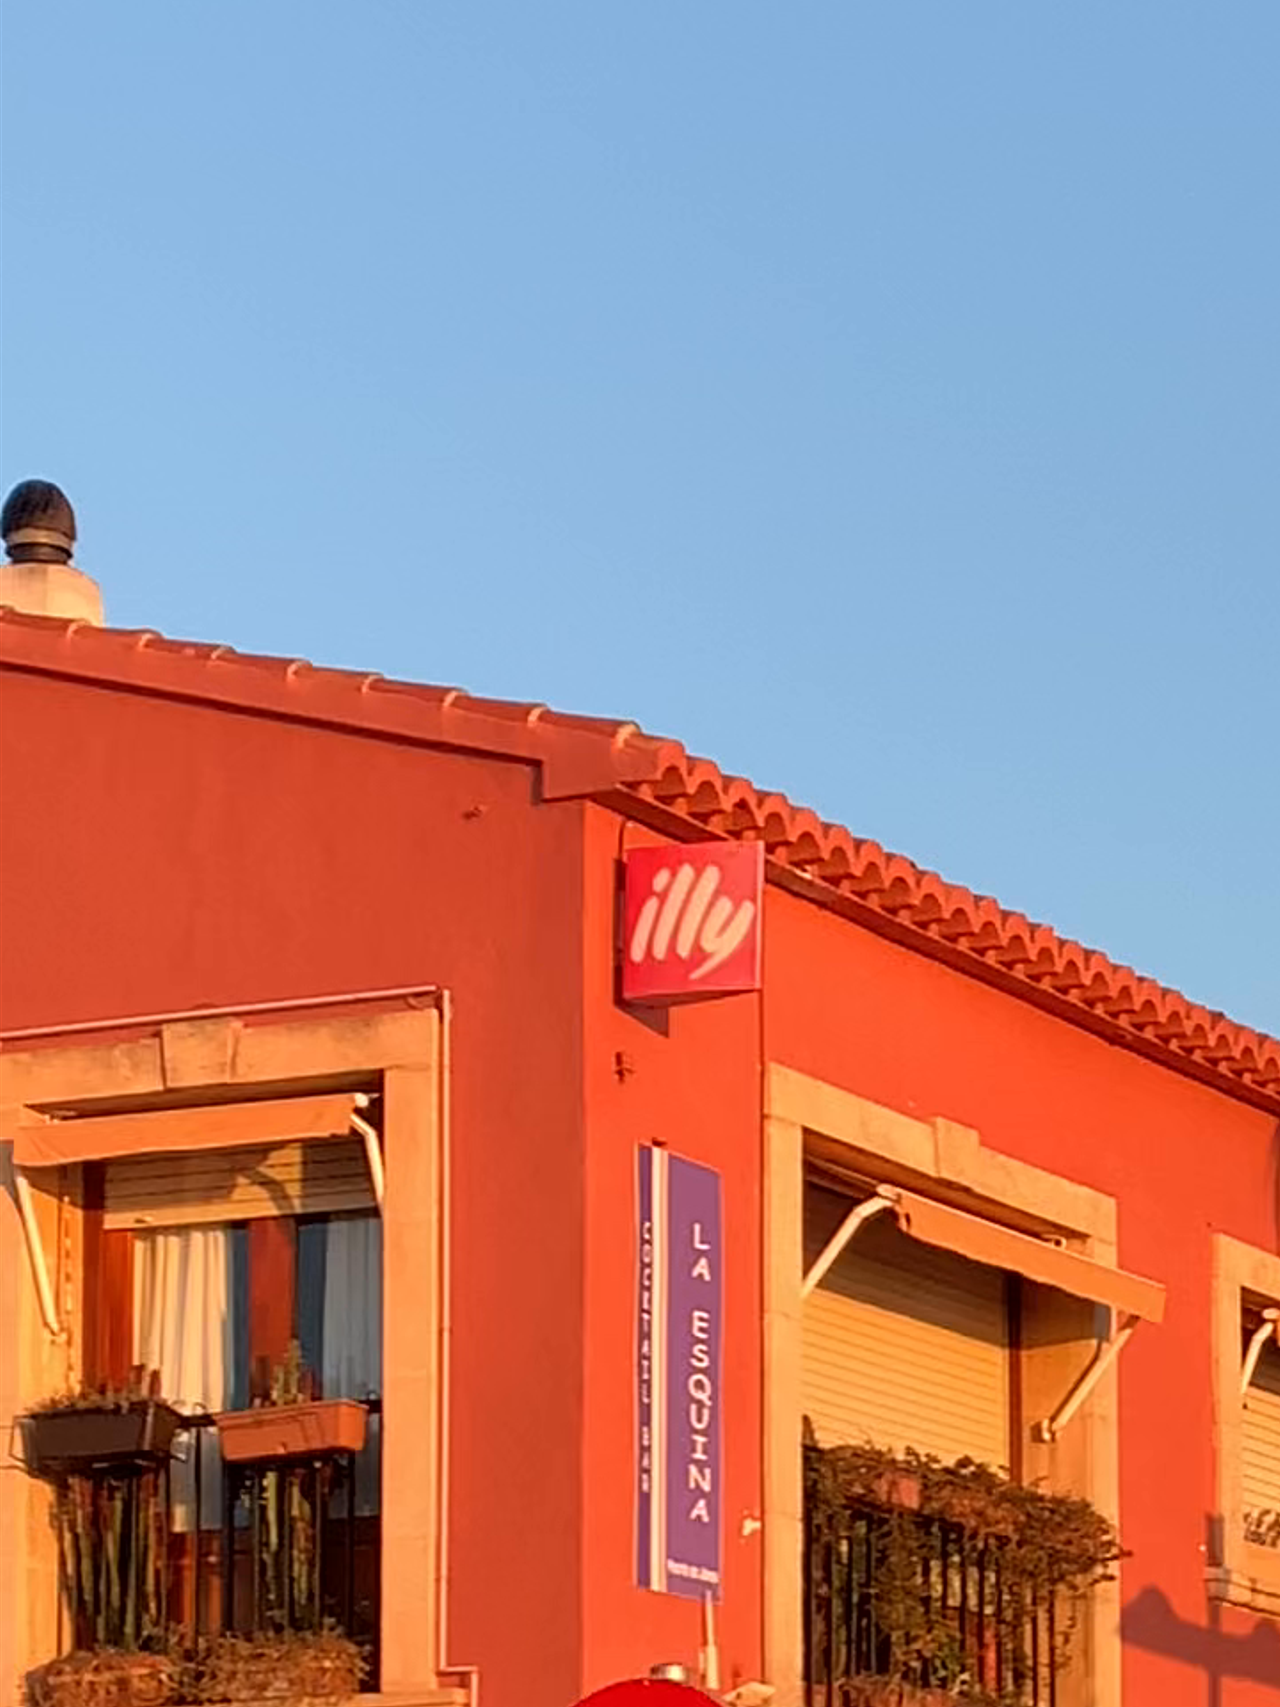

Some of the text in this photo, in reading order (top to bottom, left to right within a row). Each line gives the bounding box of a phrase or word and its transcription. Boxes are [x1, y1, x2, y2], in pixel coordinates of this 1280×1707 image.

[630, 863, 755, 980] illy
[688, 1223, 712, 1523] LA ESQUINA
